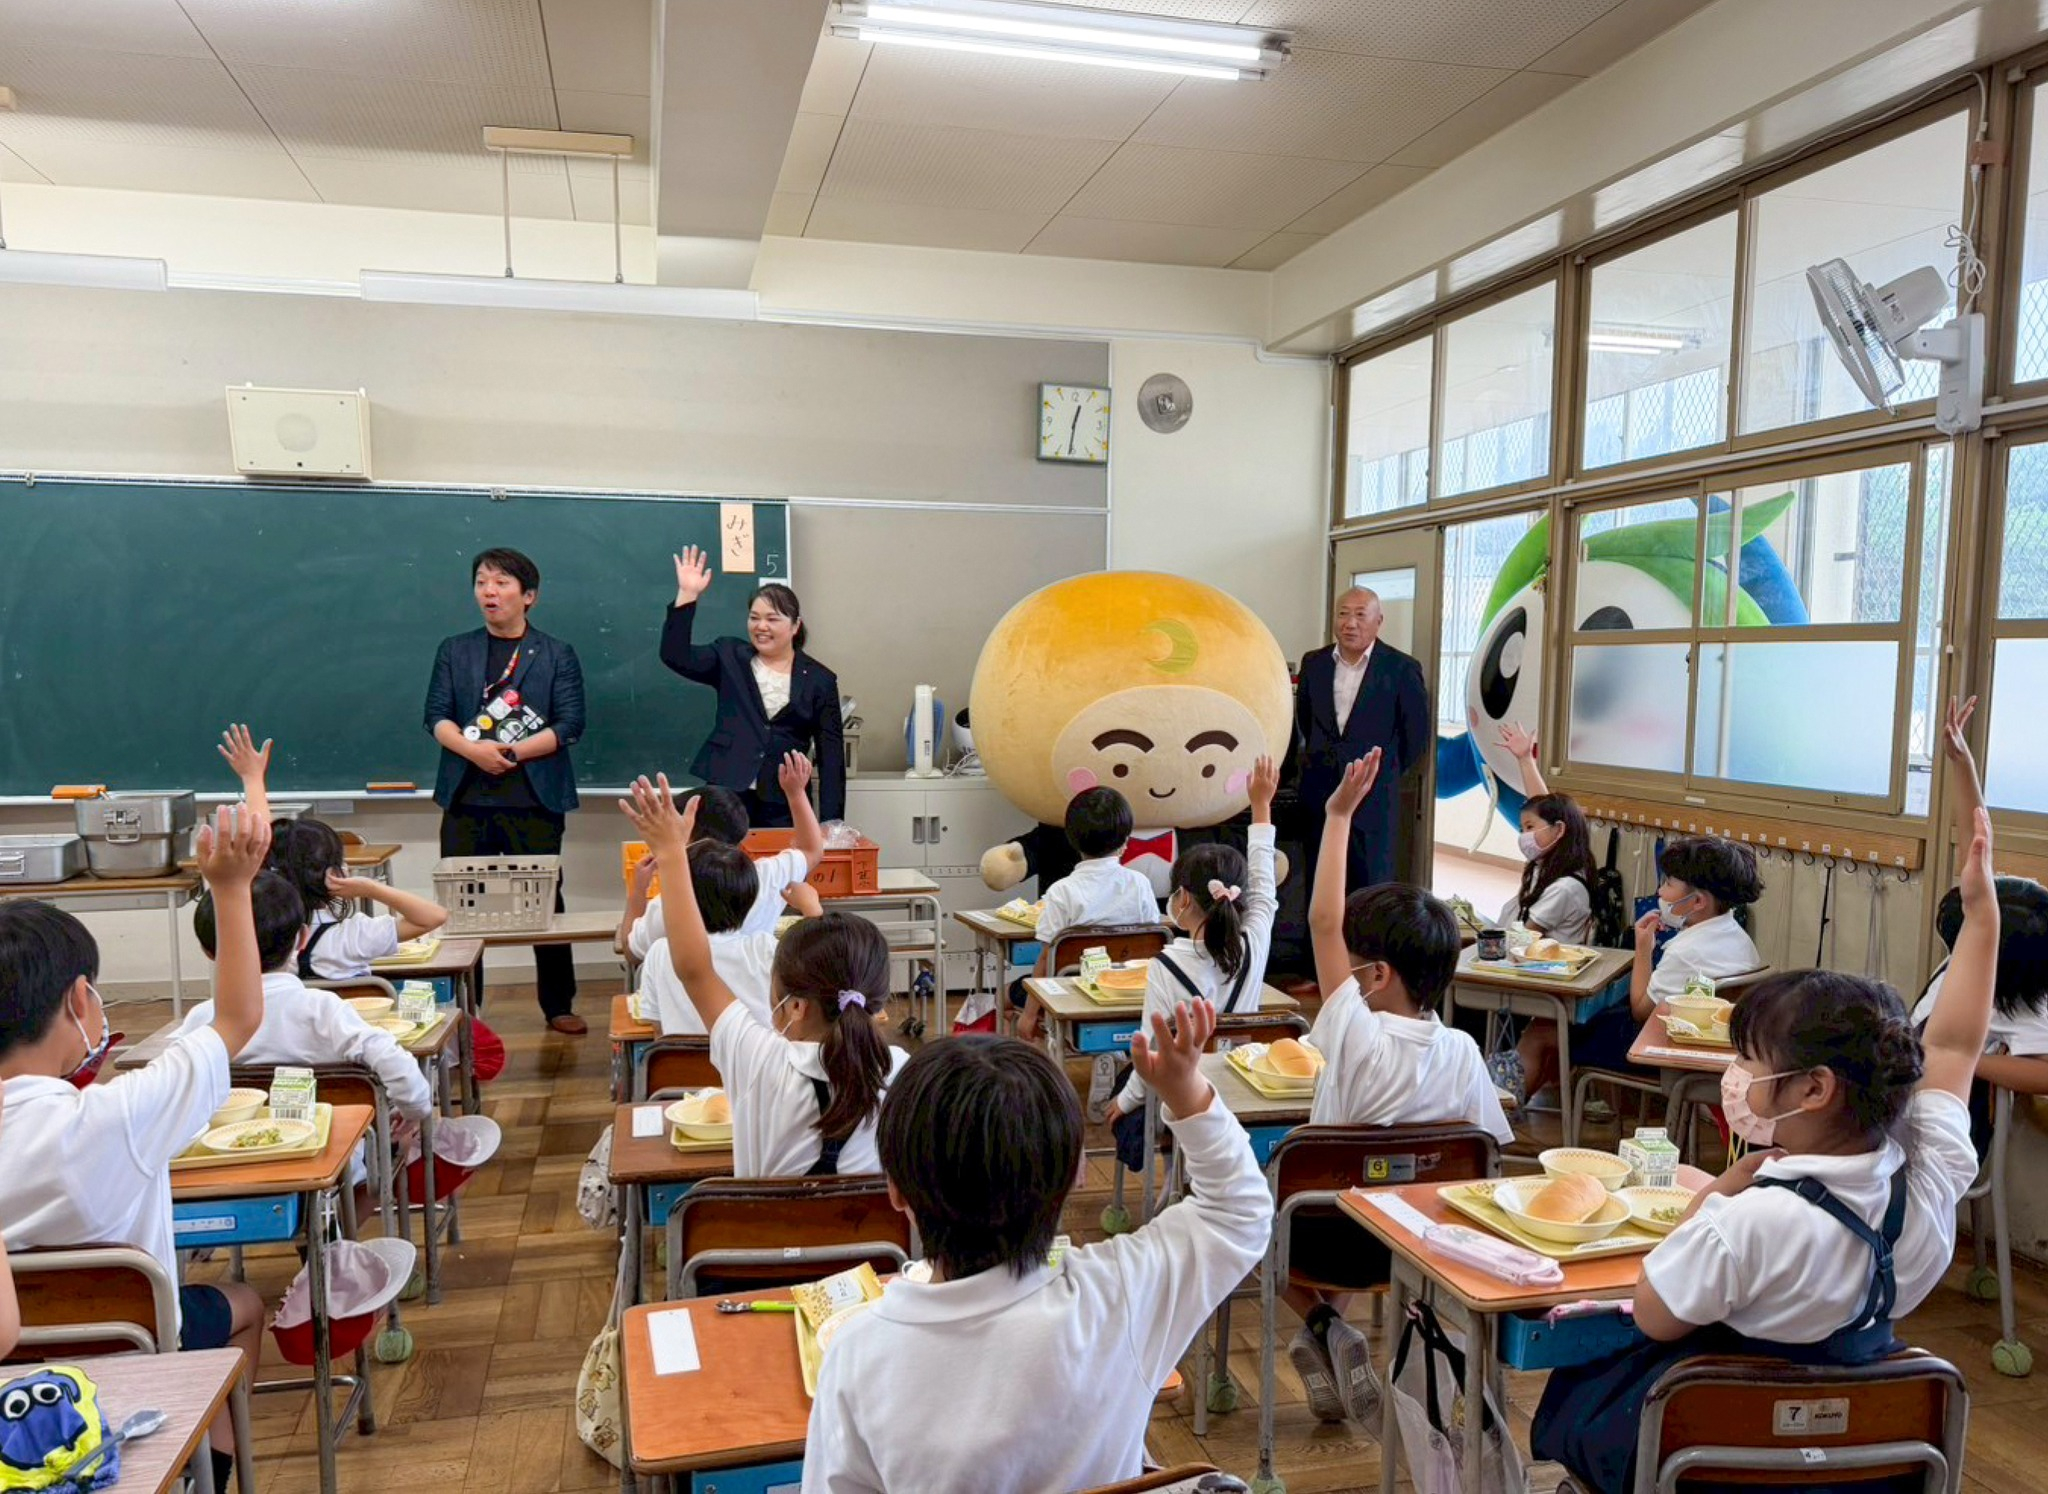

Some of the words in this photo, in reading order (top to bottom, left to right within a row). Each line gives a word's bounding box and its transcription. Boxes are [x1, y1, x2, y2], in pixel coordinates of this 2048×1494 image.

[726, 514, 750, 557] みぎ
[767, 553, 779, 575] 5
[1373, 1160, 1383, 1171] 6
[1788, 1406, 1802, 1421] 7
